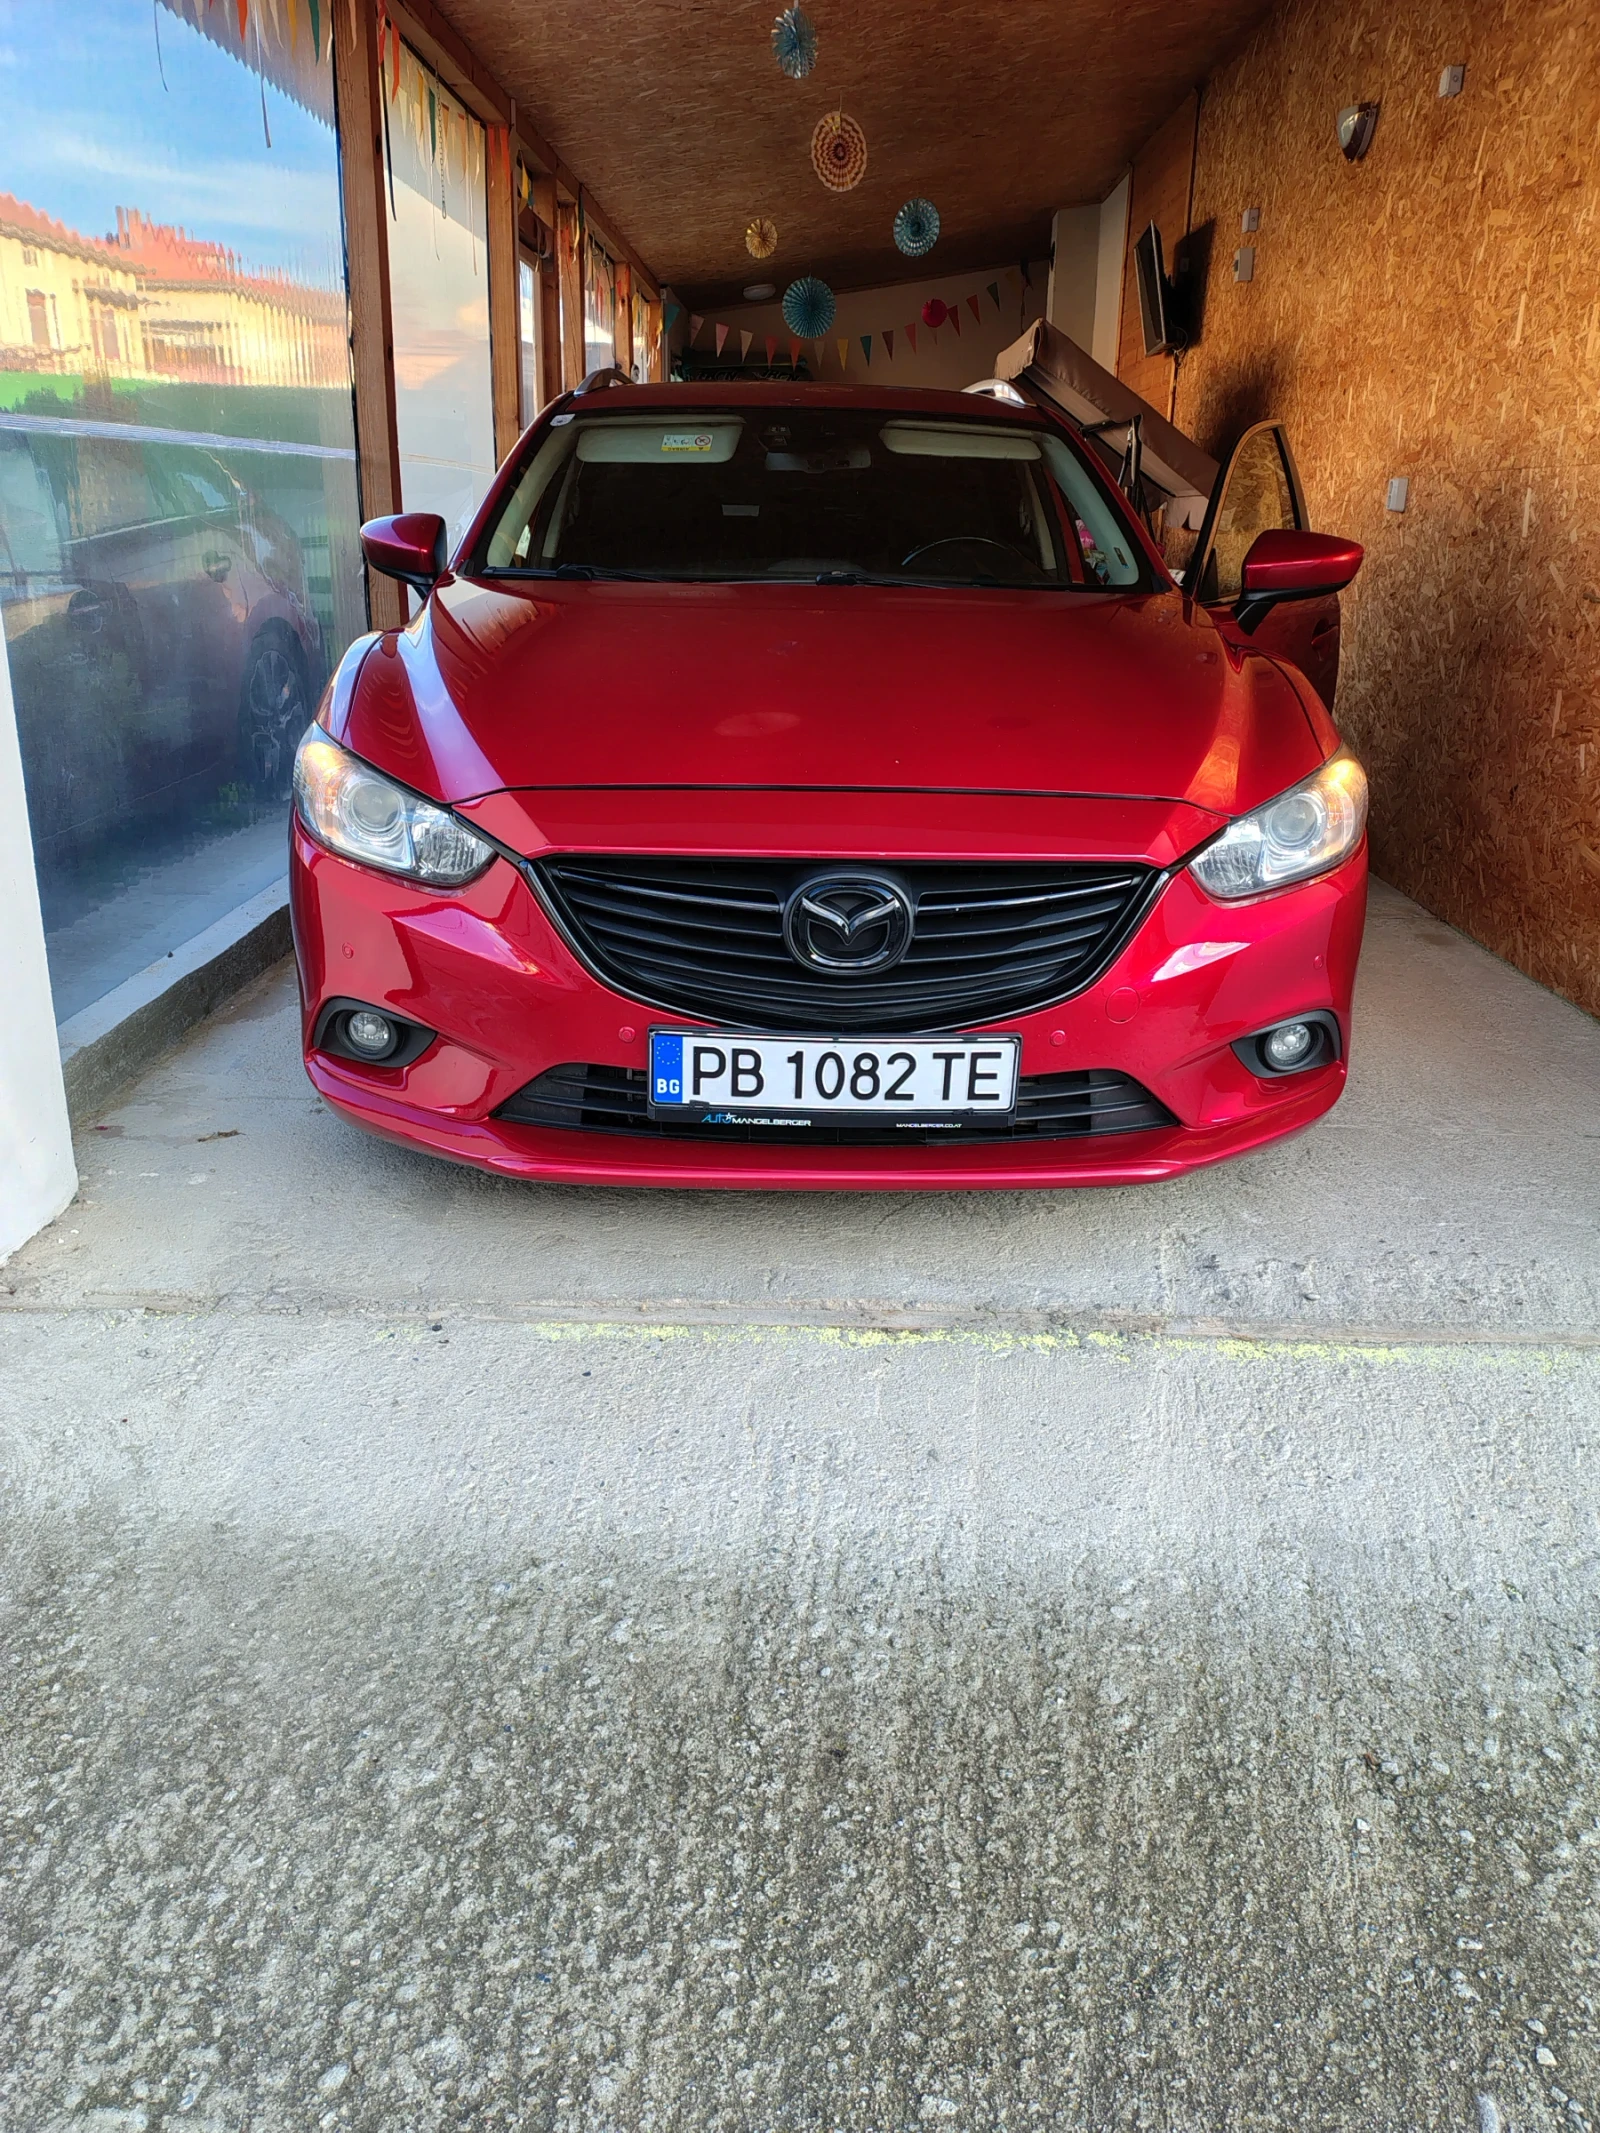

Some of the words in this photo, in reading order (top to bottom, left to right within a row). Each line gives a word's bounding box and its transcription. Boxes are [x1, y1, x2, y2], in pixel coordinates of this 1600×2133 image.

[656, 1078, 680, 1095] BG
[692, 1046, 764, 1097] PB
[787, 1050, 916, 1101] 1082
[932, 1052, 1003, 1101] TE
